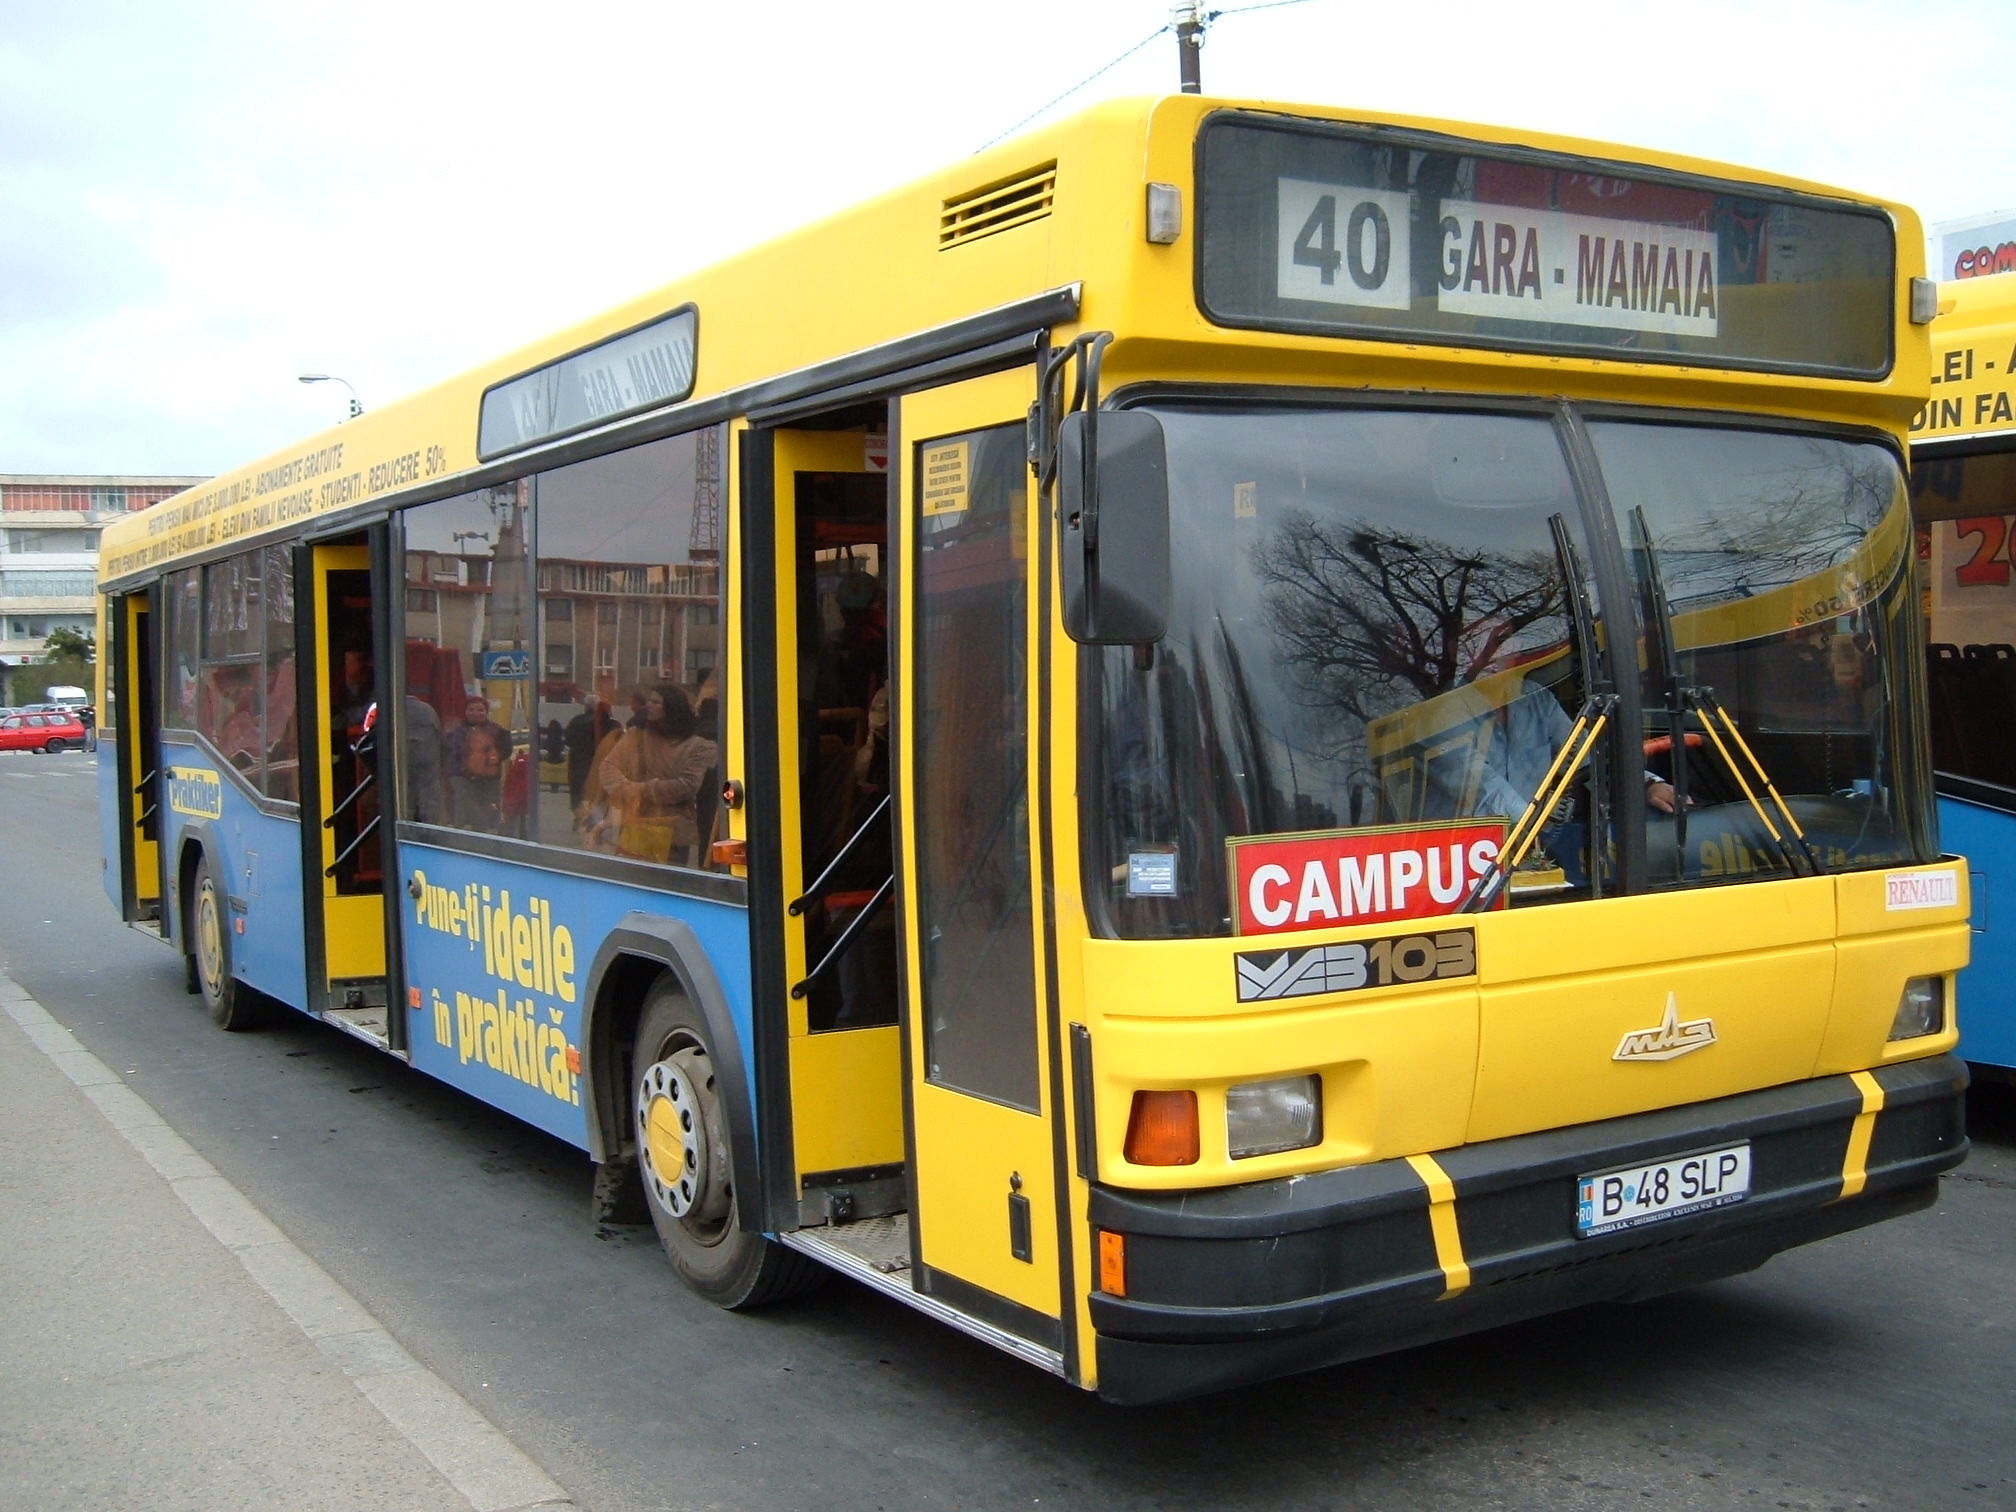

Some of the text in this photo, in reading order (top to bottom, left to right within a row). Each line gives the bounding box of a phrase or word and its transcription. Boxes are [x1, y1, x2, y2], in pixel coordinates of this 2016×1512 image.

[1293, 194, 1391, 291] 40
[1438, 215, 1542, 300] GARA
[1576, 233, 1717, 321] MAMAIA
[1975, 391, 2016, 425] FA
[319, 471, 362, 510] STUDENTI
[368, 450, 421, 494] REDUCERE
[425, 444, 447, 477] 50%
[1249, 839, 1500, 928] CAMPUS
[1887, 877, 1954, 906] RENAULT
[482, 884, 576, 1003] ideile
[1579, 1205, 1593, 1223] RO
[1602, 1153, 1738, 1217] B 48 SLP
